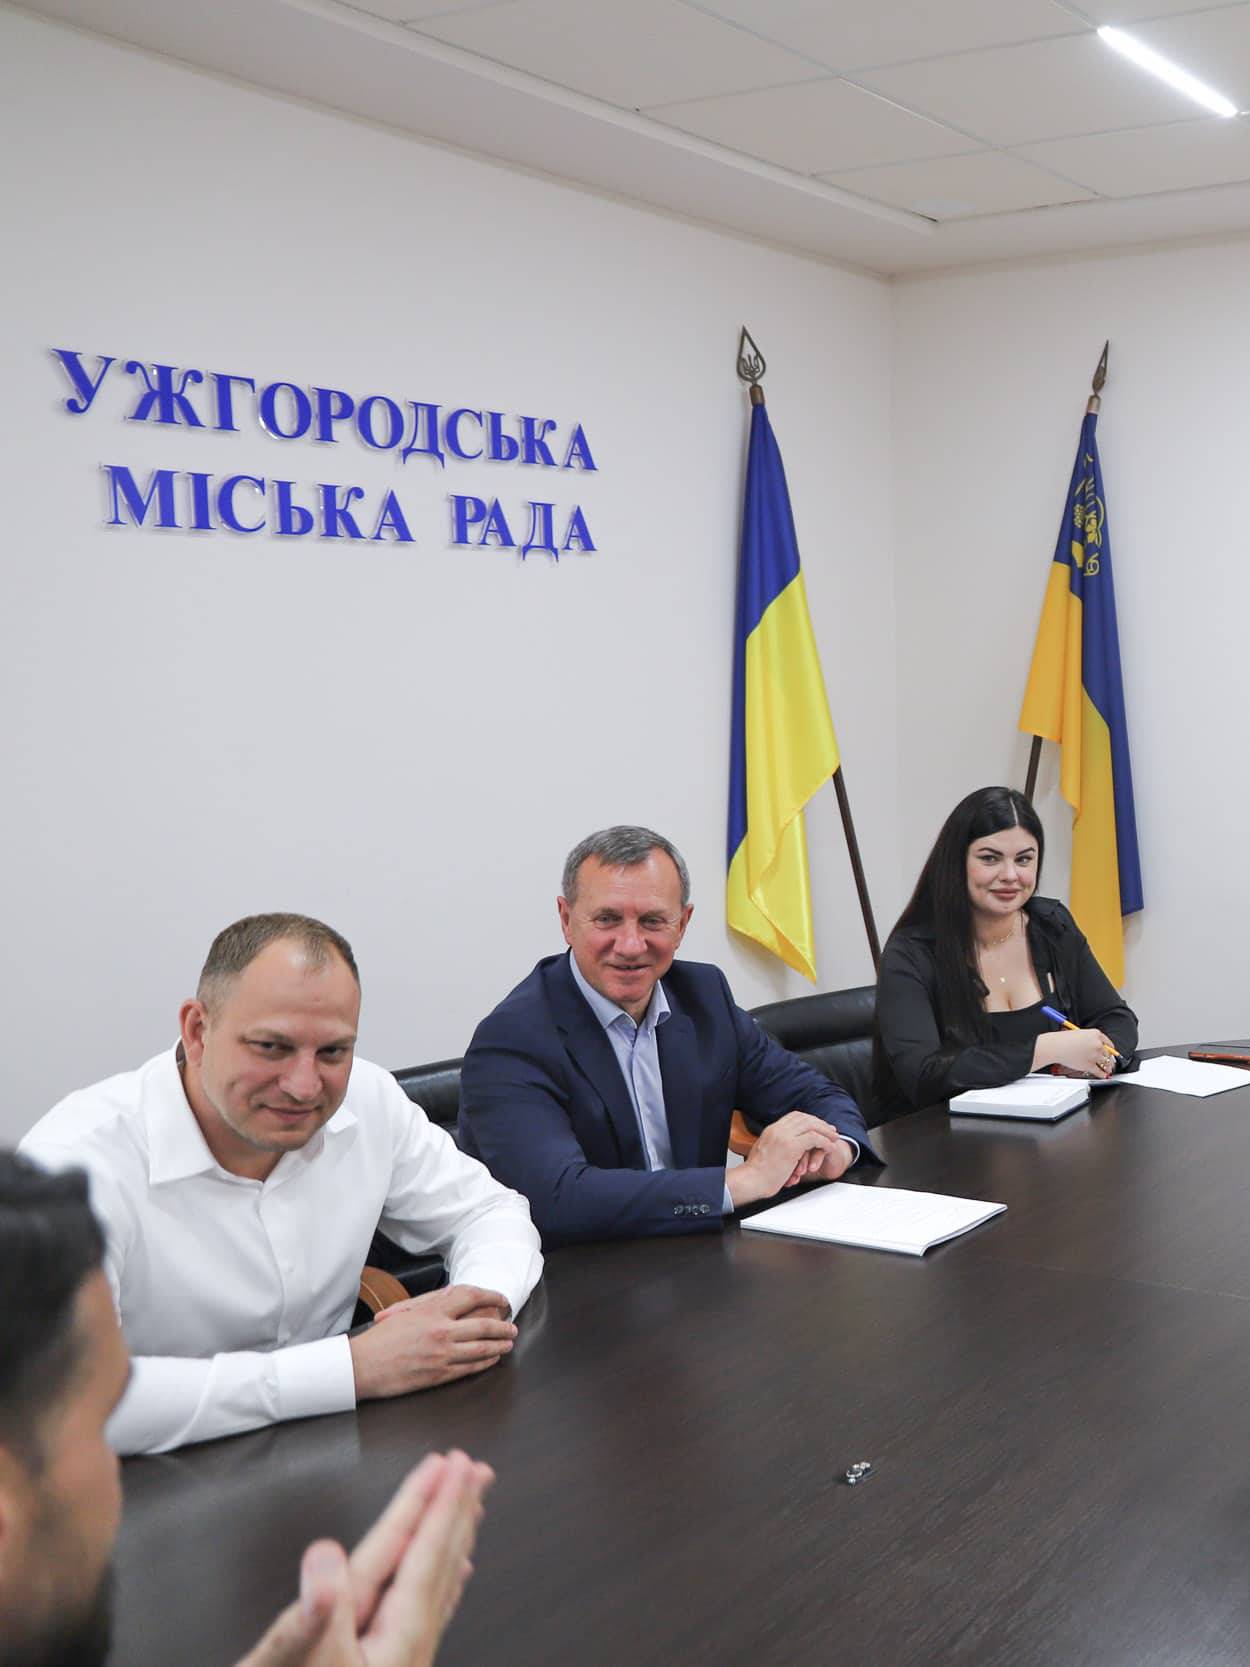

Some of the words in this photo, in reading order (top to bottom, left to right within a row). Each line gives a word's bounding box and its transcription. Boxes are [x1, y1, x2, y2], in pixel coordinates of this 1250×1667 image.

[51, 348, 598, 471] УЖГОРОДСЬКА
[102, 464, 415, 543] МІСЬКА
[450, 494, 597, 562] РАДА
